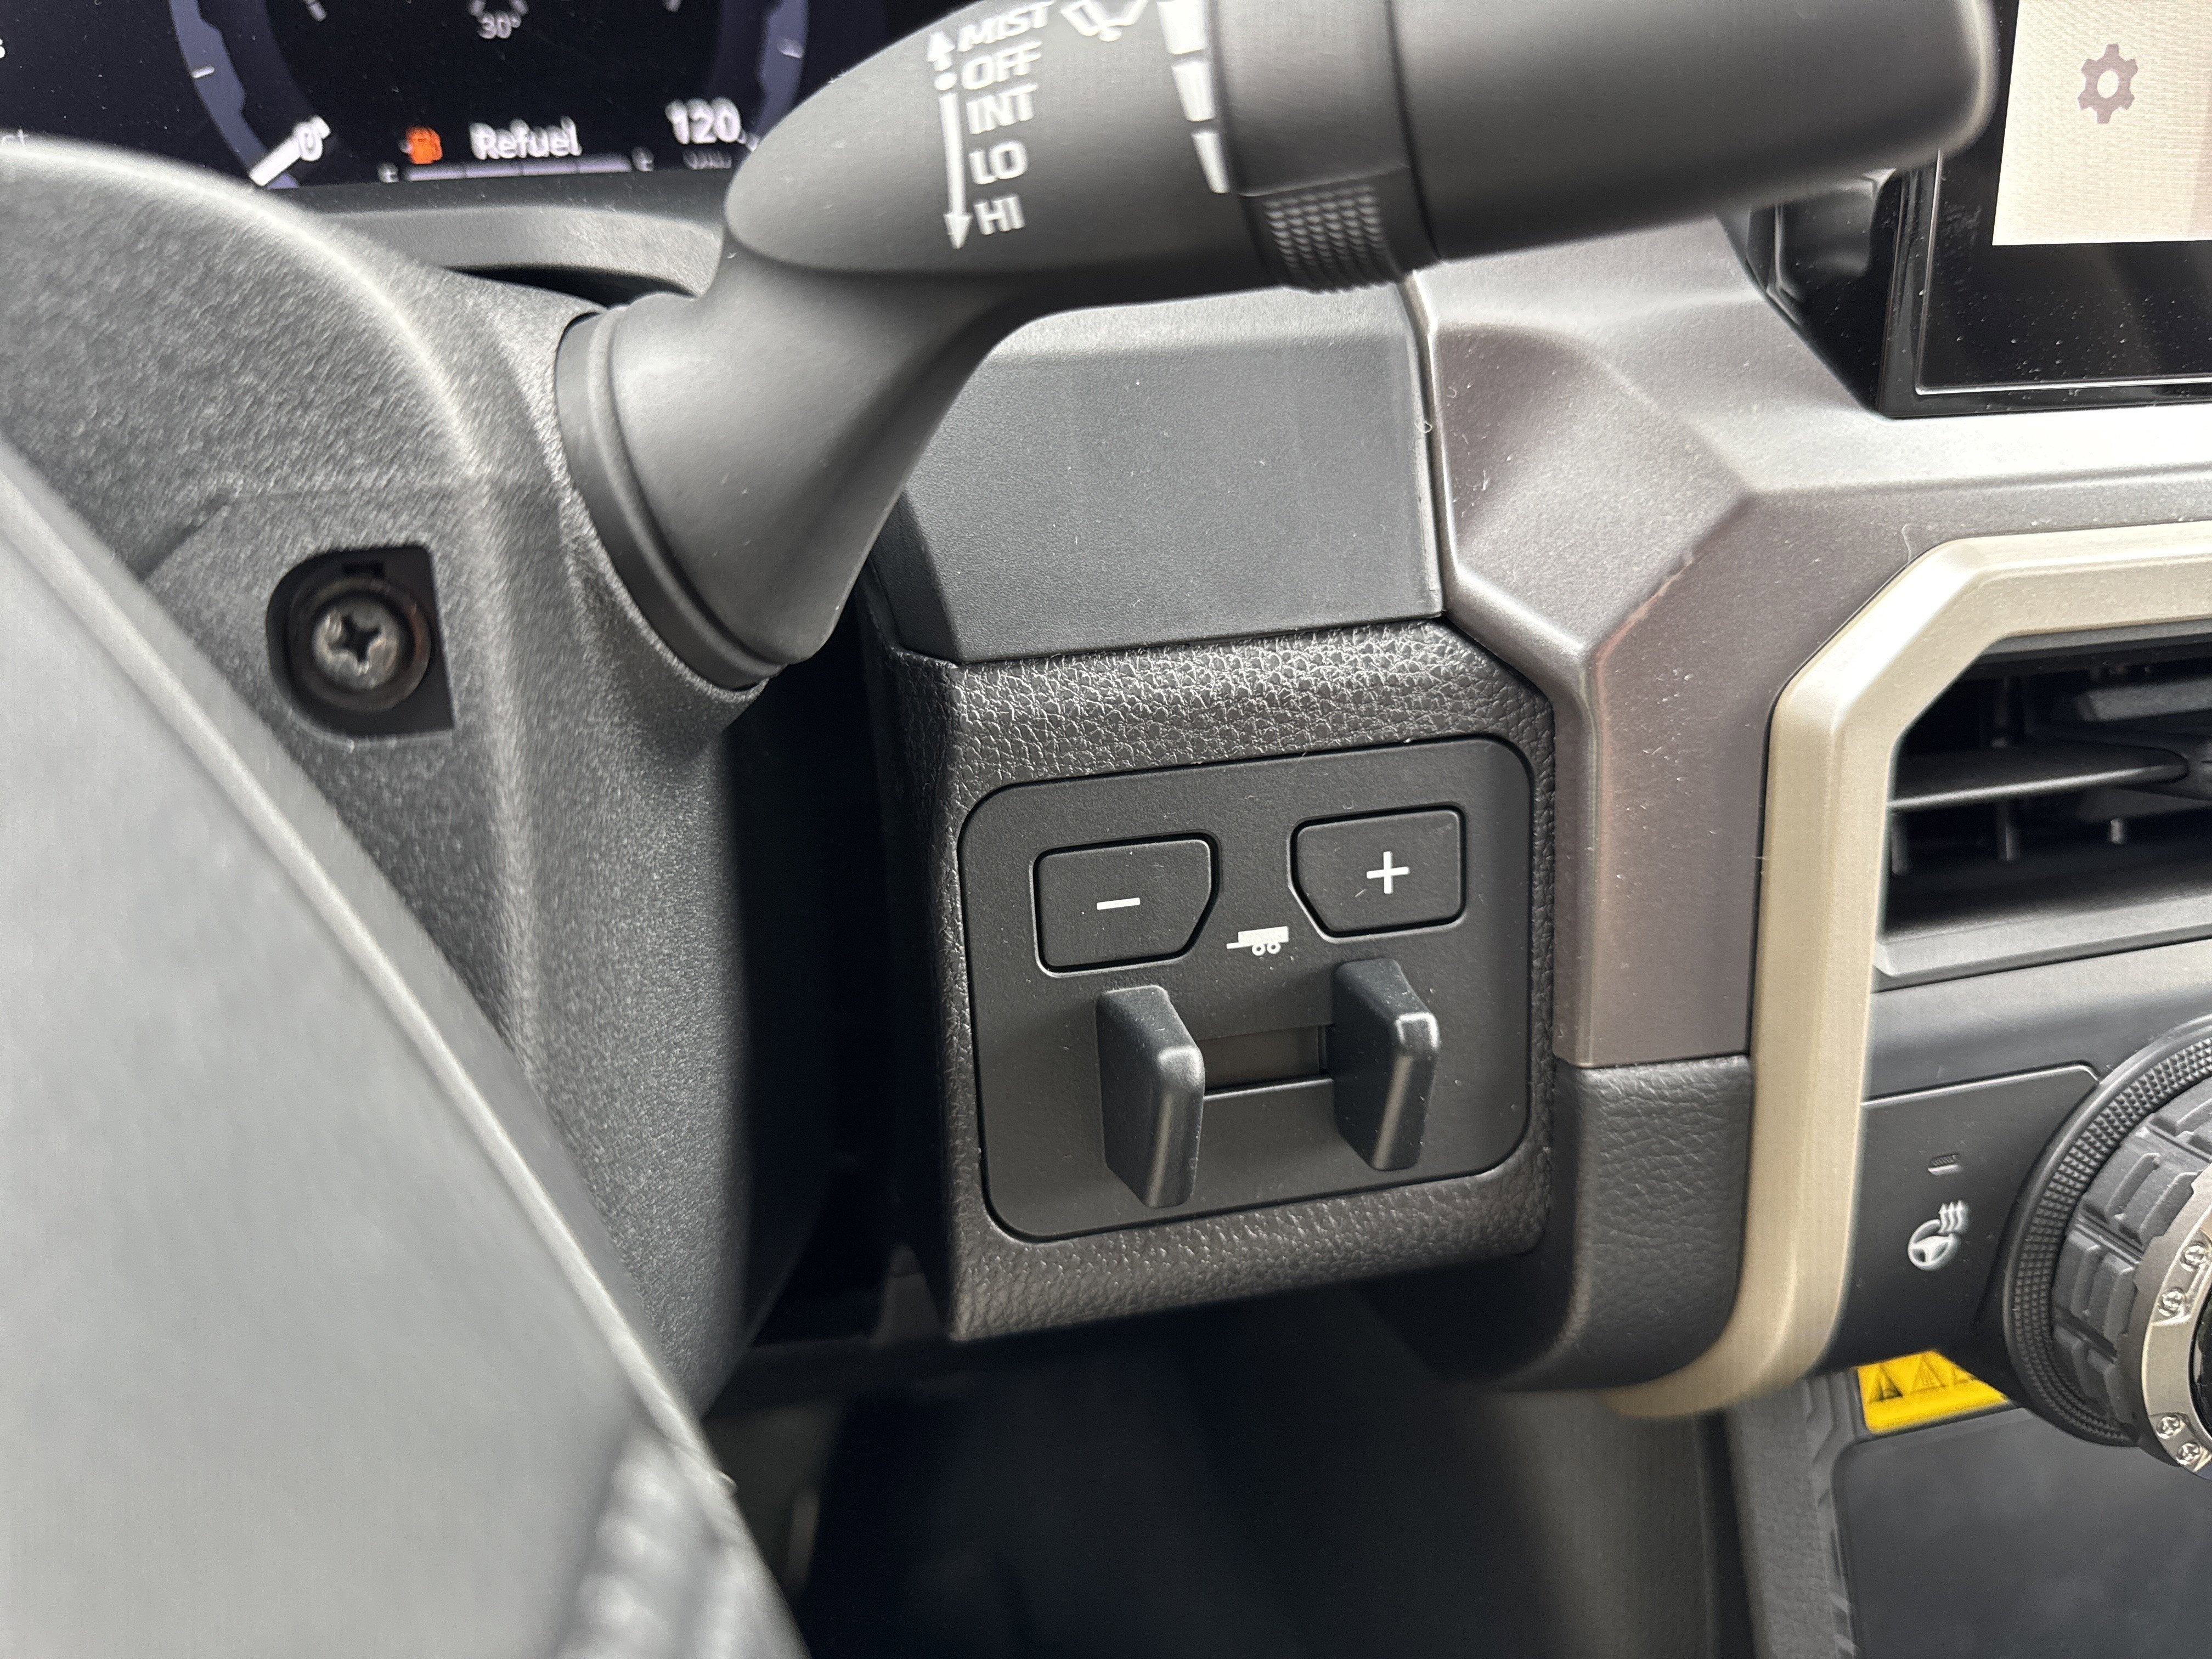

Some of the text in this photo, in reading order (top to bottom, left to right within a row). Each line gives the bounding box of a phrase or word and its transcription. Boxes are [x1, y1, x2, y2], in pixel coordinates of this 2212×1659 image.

[958, 1, 1053, 52] MIST
[962, 41, 1042, 90] OFF
[966, 83, 1037, 134] INT
[469, 116, 583, 160] Refuel
[969, 140, 1029, 185] LO
[973, 194, 1026, 235] HI
